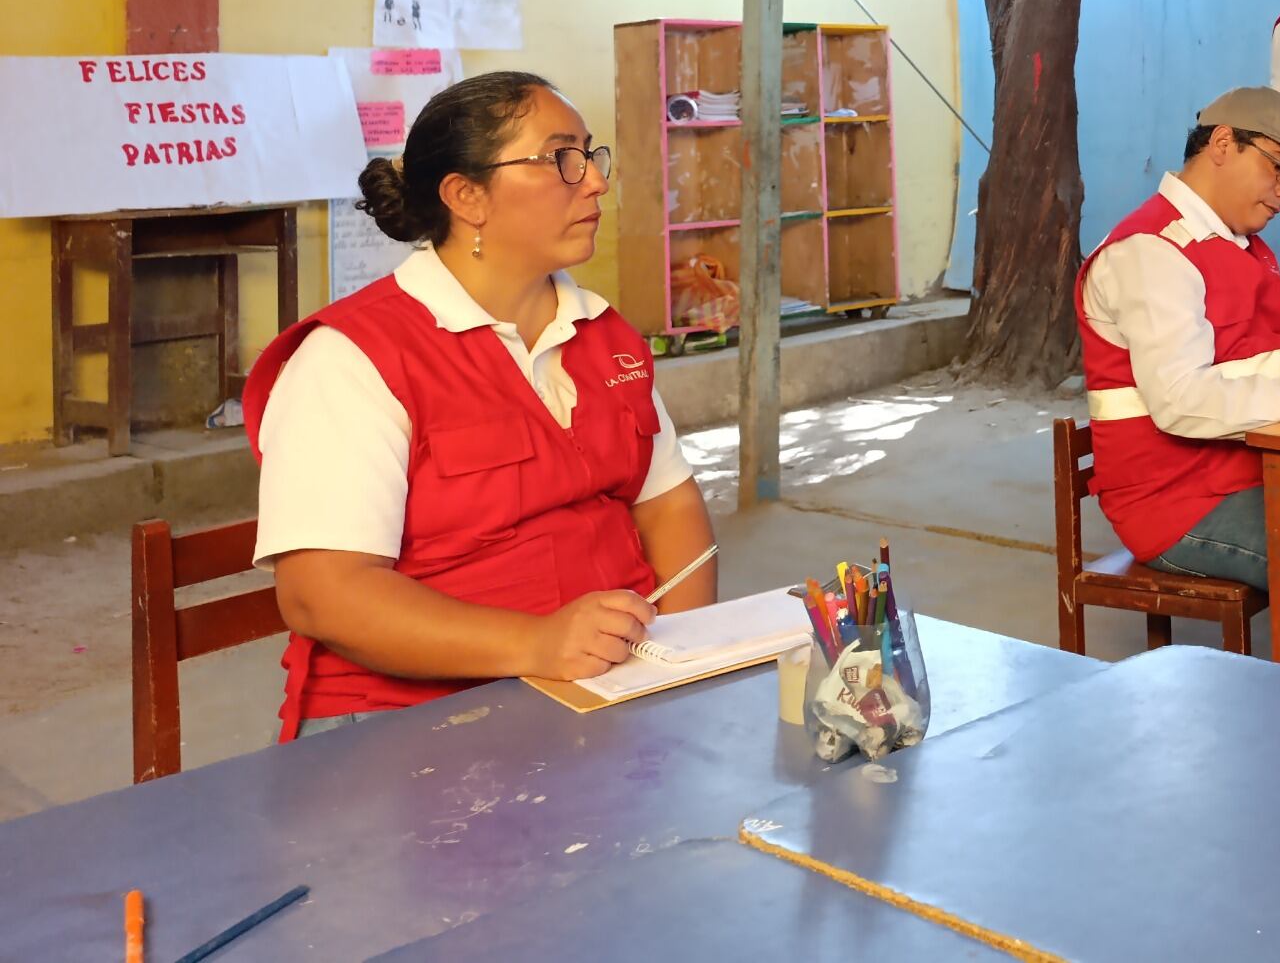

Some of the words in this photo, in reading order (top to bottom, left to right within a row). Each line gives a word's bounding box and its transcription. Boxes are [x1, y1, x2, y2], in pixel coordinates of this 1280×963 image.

[79, 60, 207, 83] FELICES
[124, 101, 246, 126] FIESTAS
[121, 137, 237, 167] PATRIAS
[605, 378, 619, 387] LA
